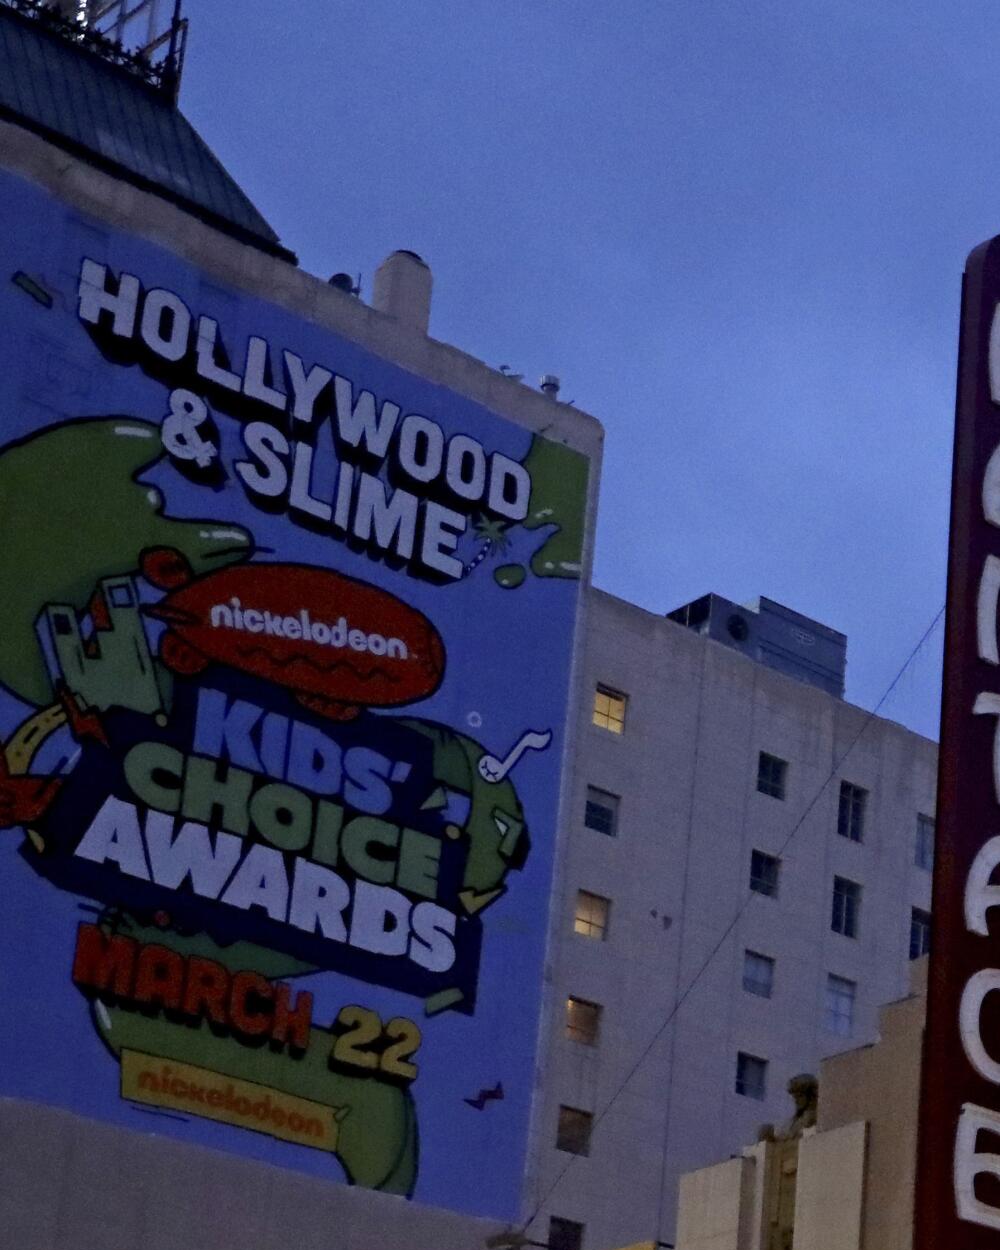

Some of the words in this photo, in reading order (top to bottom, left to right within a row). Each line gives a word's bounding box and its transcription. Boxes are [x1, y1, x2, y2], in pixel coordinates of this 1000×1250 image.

[78, 257, 532, 521] HOLLYWOOD
[160, 388, 217, 468] &
[235, 421, 467, 581] SLIME
[209, 596, 408, 660] nickelodeon
[74, 795, 457, 973] AWARDS
[122, 741, 442, 899] CHOICE
[72, 923, 313, 1051] MARCH
[333, 1005, 421, 1079] 22
[137, 1065, 324, 1139] nickelodeon
